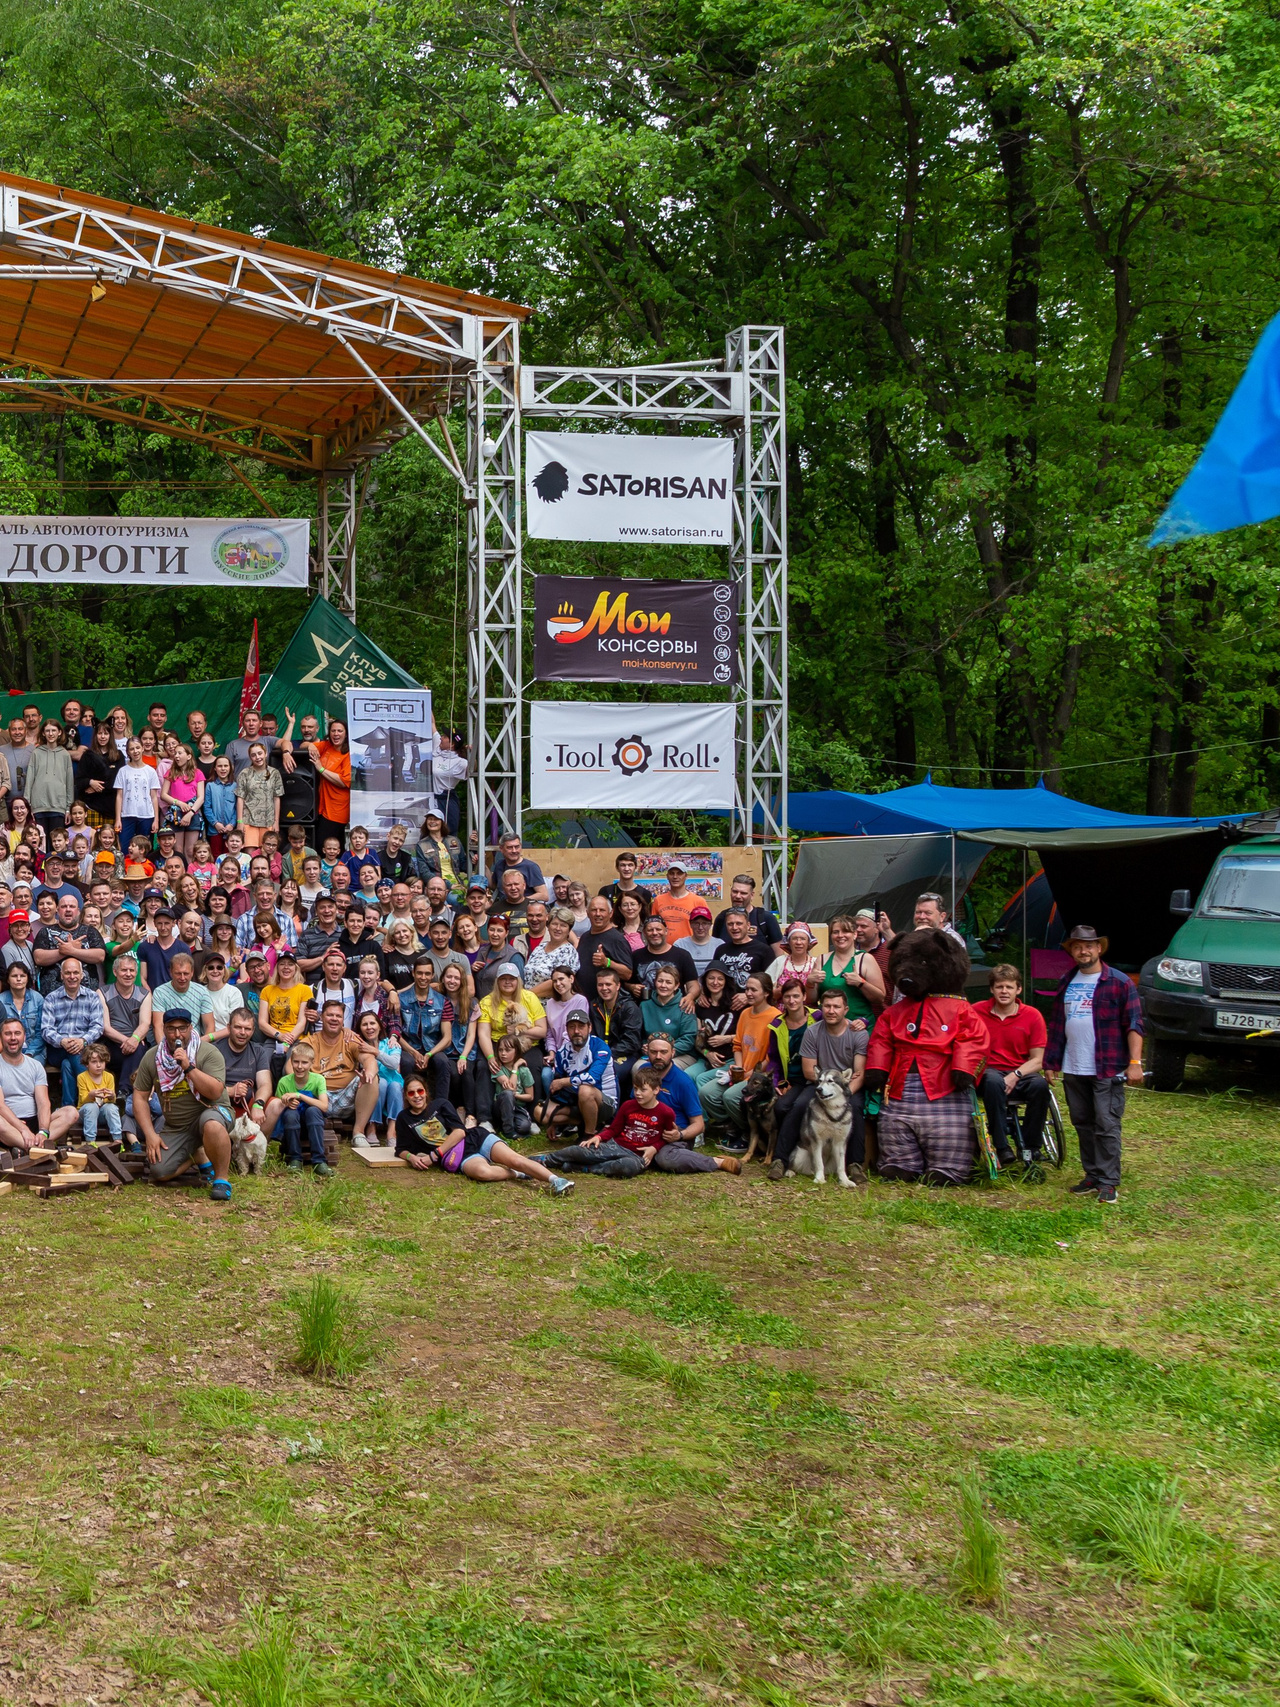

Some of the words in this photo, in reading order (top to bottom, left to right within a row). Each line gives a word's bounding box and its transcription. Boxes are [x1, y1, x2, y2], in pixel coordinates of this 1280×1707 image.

[577, 473, 727, 499] SATORISAN
[32, 524, 190, 538] АВТОМОТОТУРИЗМА
[619, 526, 723, 537] www.satorisan.ru
[7, 543, 190, 578] ДОРОГИ
[214, 559, 251, 580] РУССКИЕ
[253, 562, 286, 581] ДОРОГИ
[598, 638, 697, 656] консервы
[343, 660, 376, 686] UAZ
[349, 652, 388, 681] КЛУБ
[622, 658, 698, 671] moi-konservy.ru
[554, 743, 605, 768] Tool
[663, 743, 711, 768] Roll
